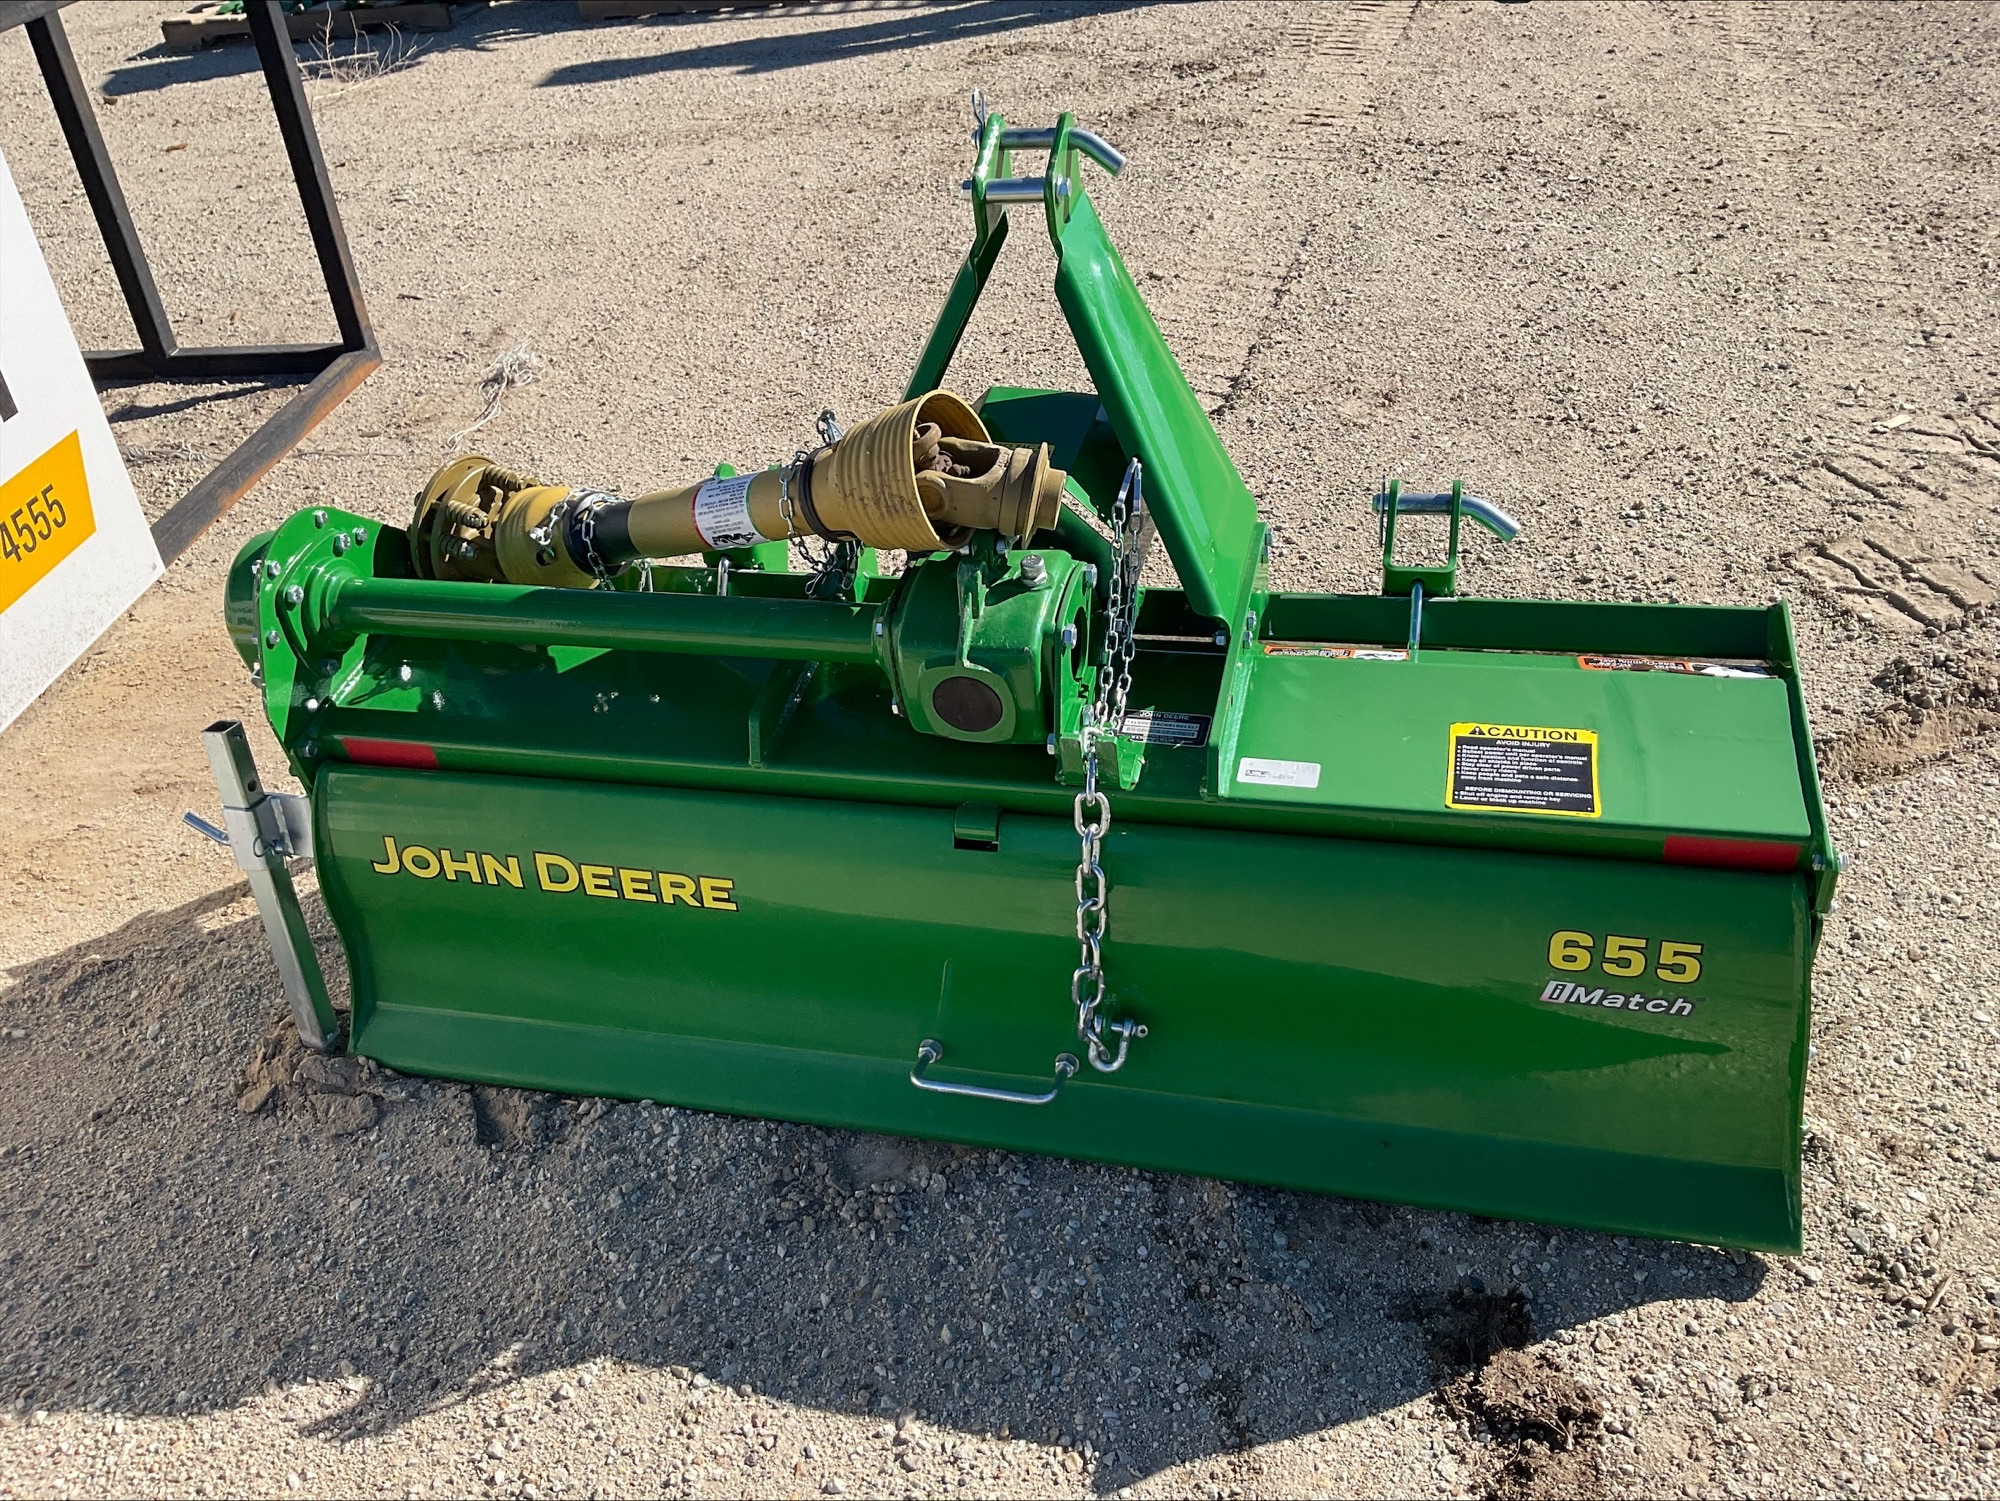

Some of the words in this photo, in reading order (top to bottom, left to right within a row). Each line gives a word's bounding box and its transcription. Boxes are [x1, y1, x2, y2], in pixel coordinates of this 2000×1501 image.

[1488, 726, 1578, 741] CAUTION
[370, 834, 526, 890] JOHN
[533, 850, 738, 912] DEERE
[1547, 929, 1704, 984] 655
[1539, 980, 1696, 1017] iMatch
